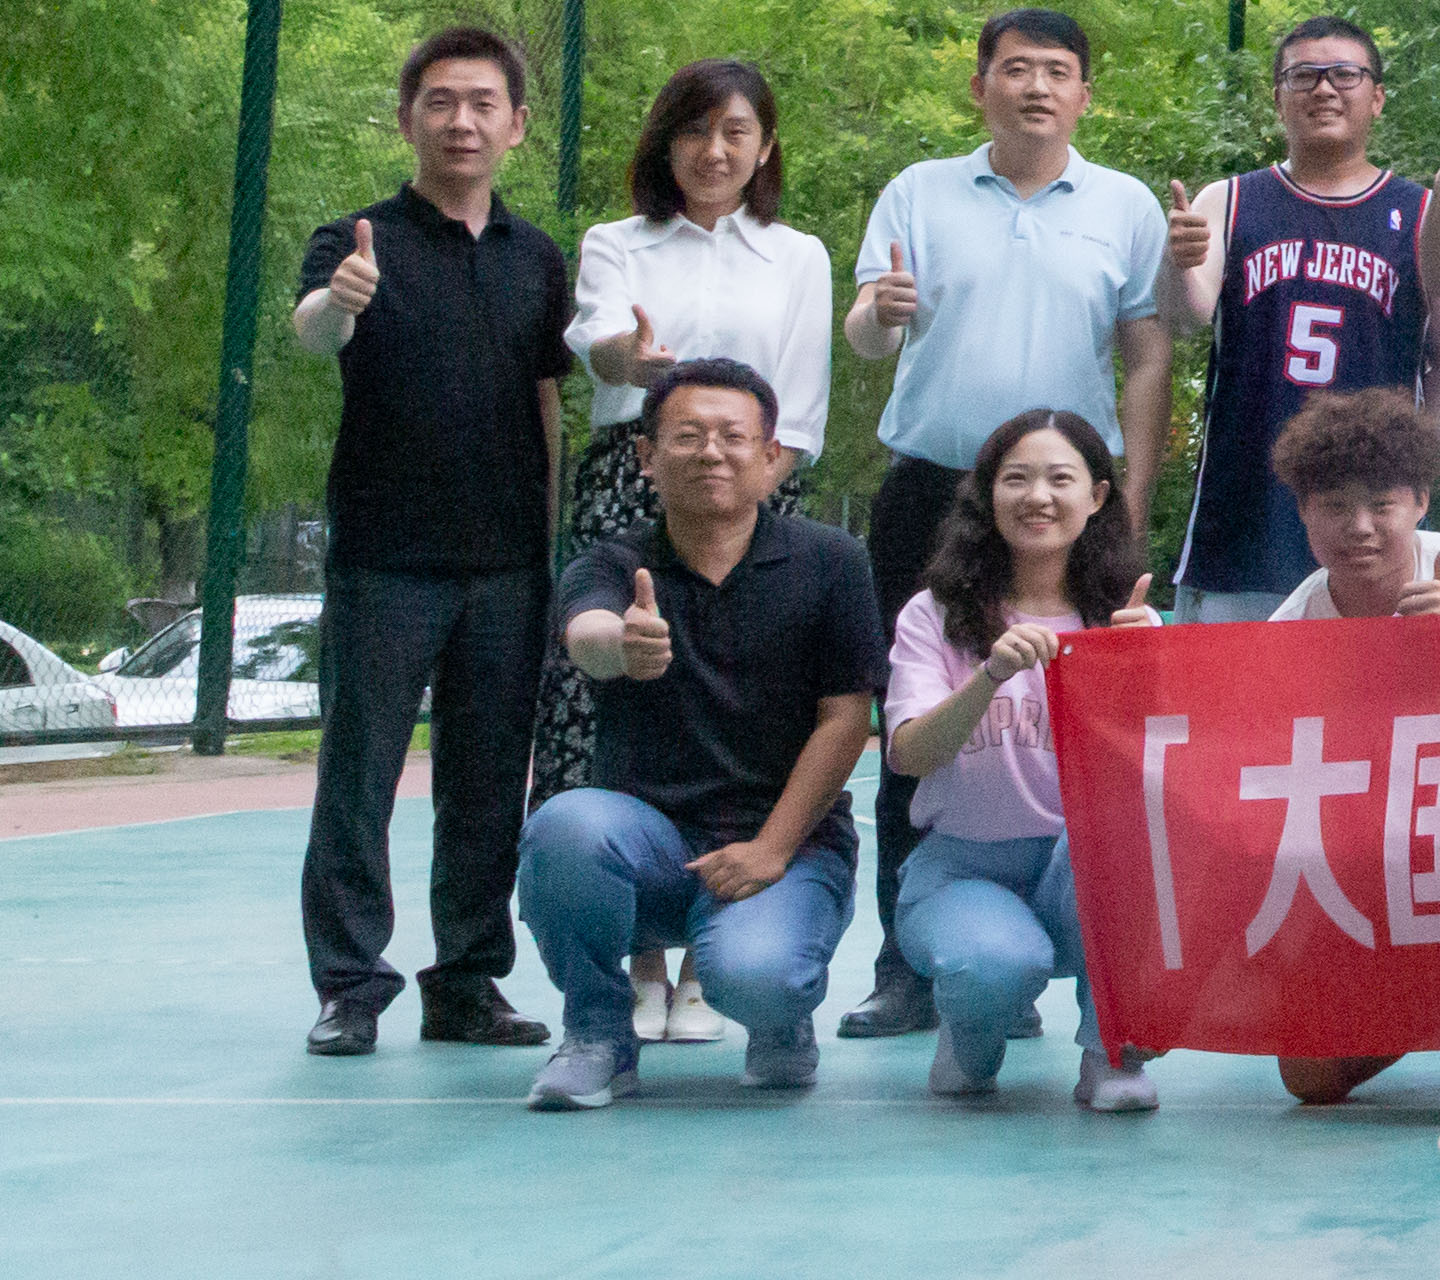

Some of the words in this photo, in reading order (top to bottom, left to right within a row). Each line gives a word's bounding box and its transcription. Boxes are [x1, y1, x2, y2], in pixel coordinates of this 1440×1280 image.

[1244, 240, 1304, 305] NEW
[1304, 240, 1400, 318] JERSEY
[1283, 301, 1345, 387] 5
